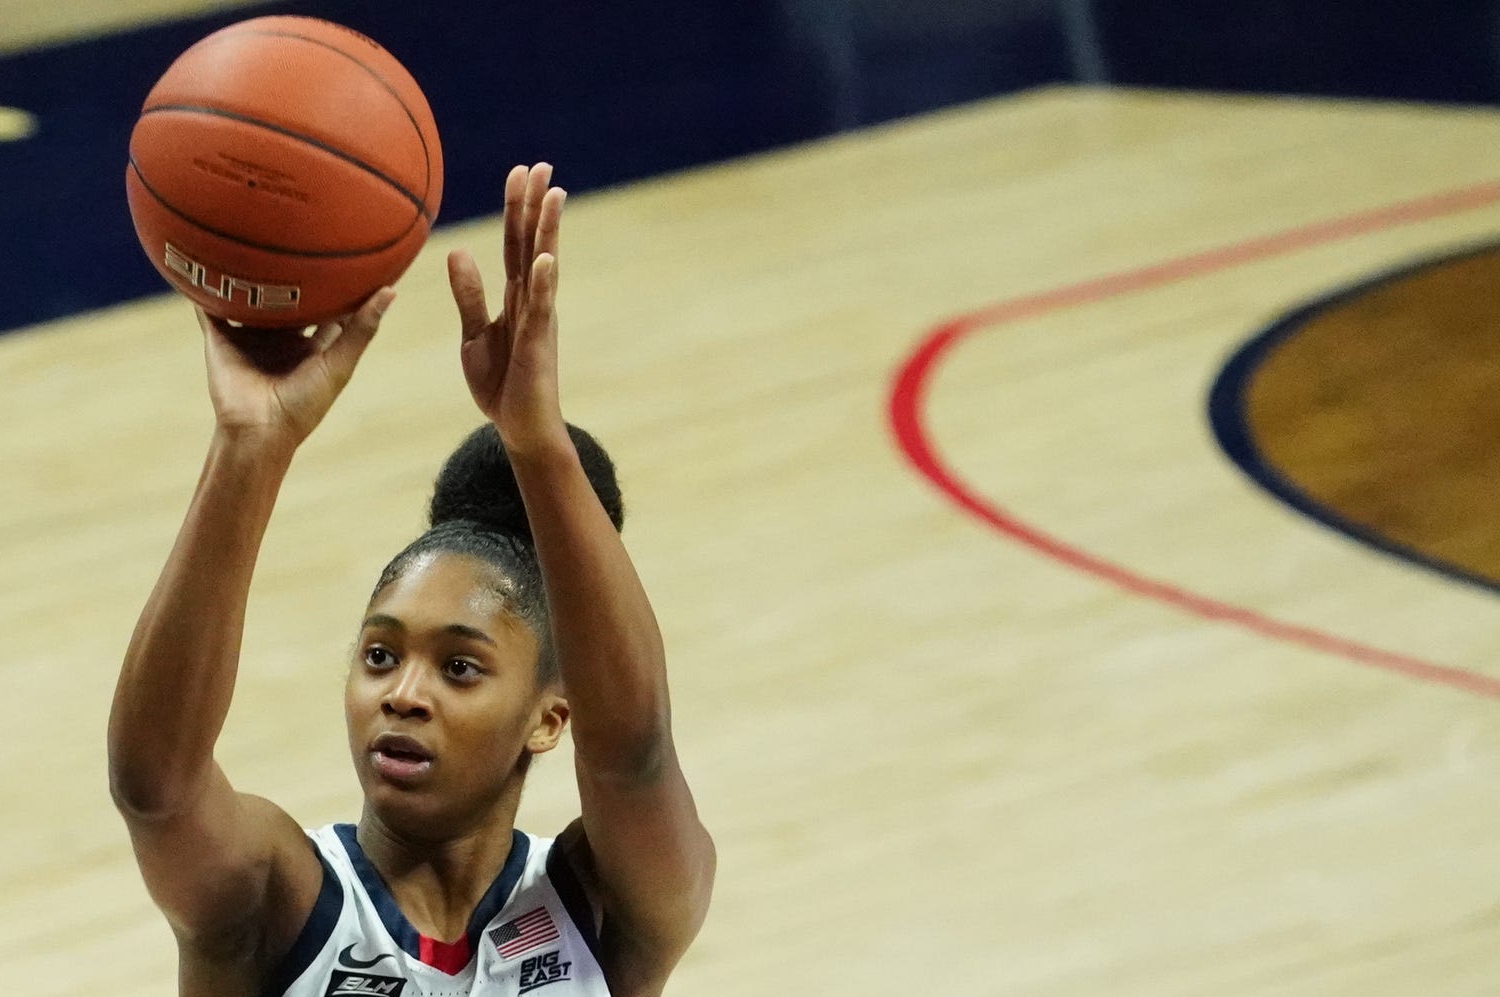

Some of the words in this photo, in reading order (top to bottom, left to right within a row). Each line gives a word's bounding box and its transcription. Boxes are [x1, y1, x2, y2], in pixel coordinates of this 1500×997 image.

[519, 961, 572, 987] EAST
[520, 950, 560, 974] BIG
[337, 976, 399, 994] BLM
